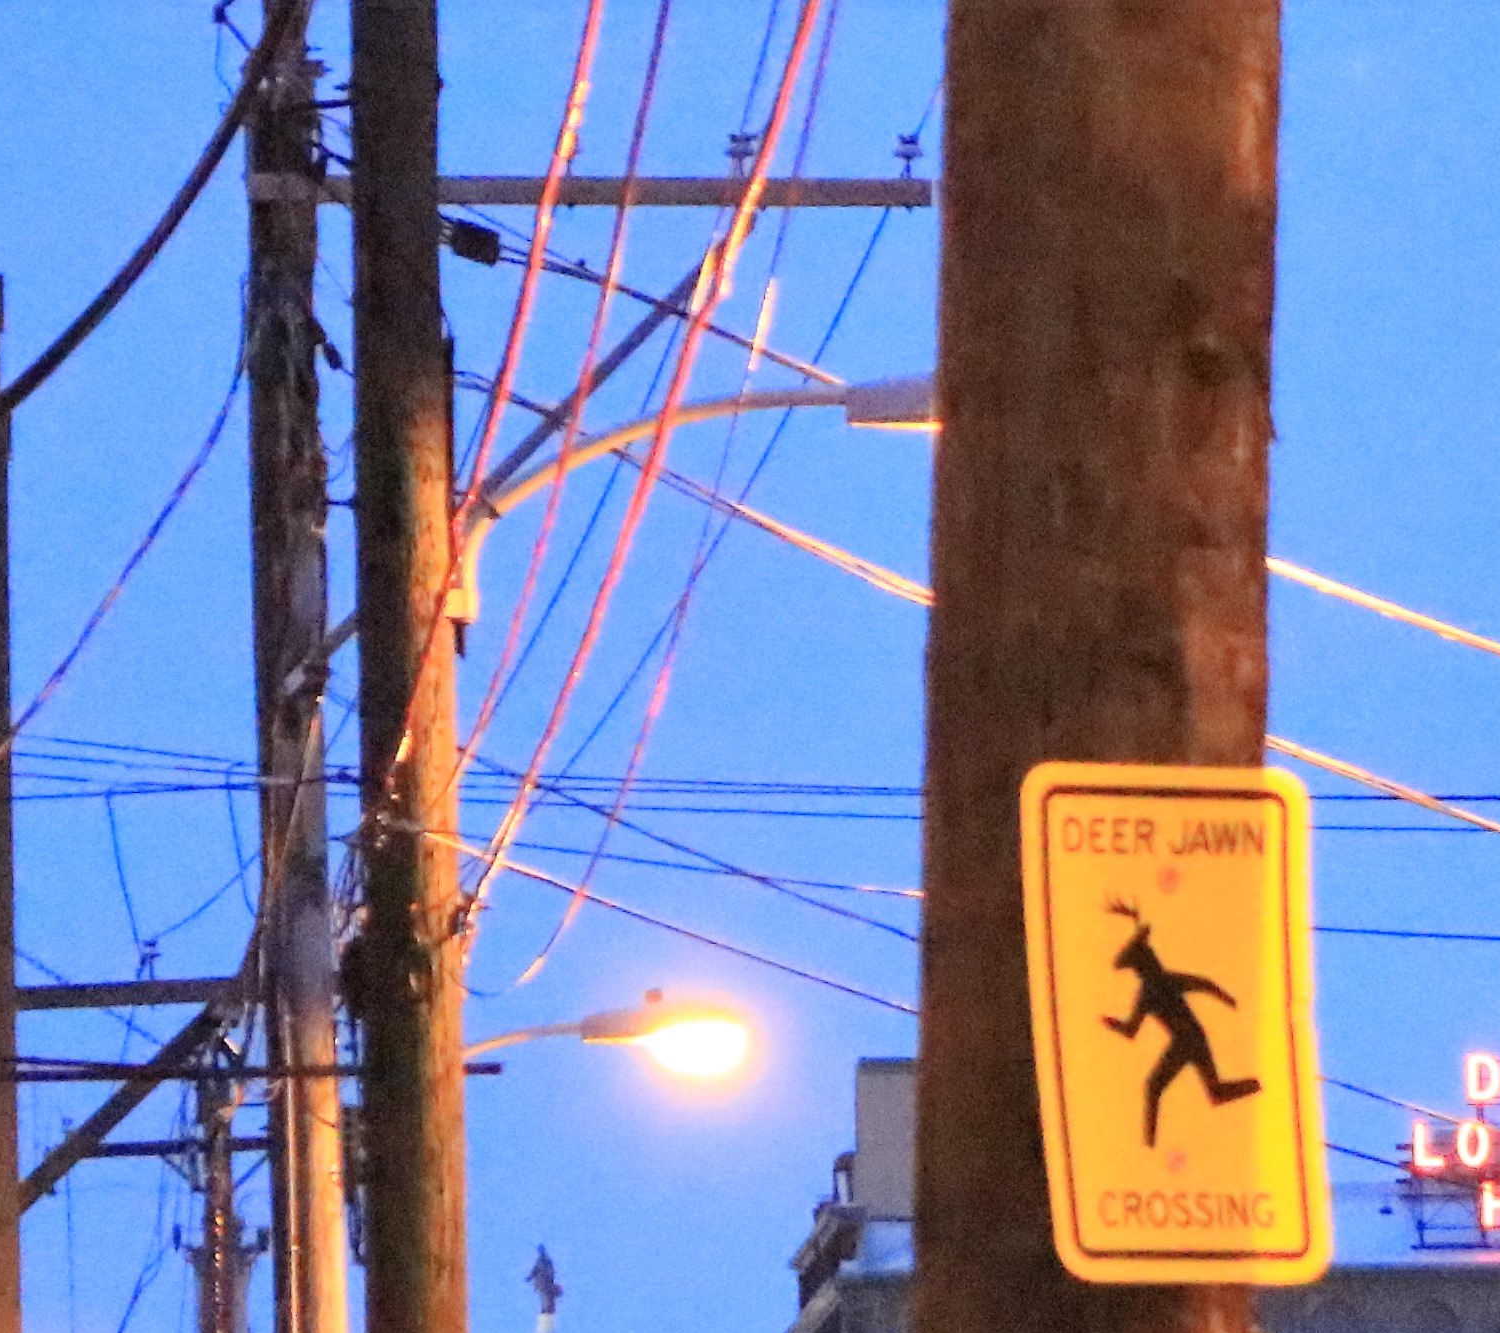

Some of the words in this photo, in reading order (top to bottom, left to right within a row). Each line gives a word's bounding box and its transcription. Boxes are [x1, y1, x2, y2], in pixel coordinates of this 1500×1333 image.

[1062, 816, 1155, 856] DEER
[1167, 818, 1267, 857] JAWN
[1097, 1192, 1277, 1230] CROSSING
